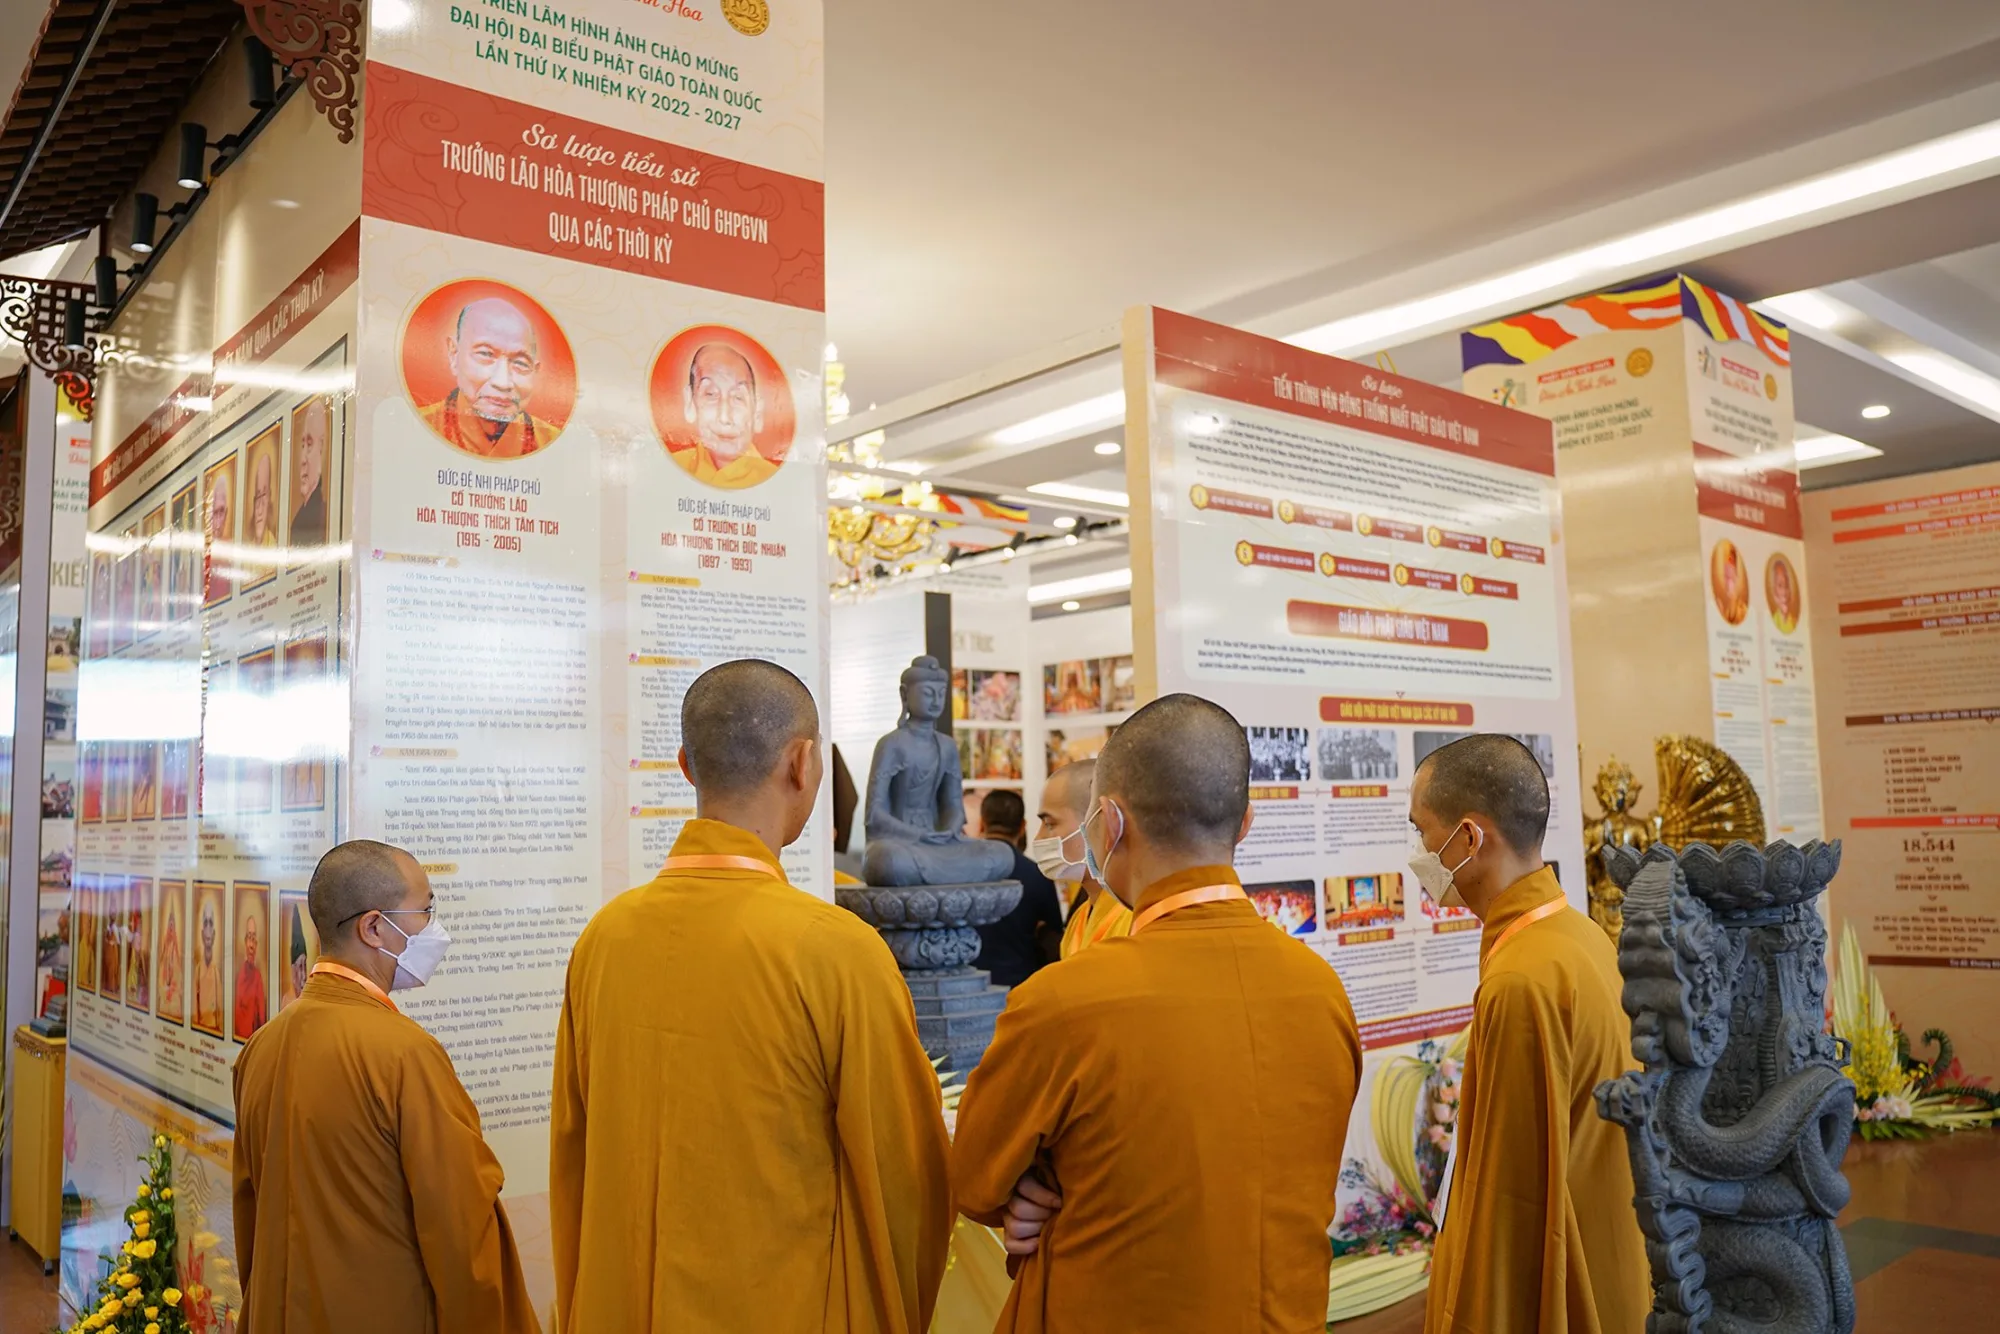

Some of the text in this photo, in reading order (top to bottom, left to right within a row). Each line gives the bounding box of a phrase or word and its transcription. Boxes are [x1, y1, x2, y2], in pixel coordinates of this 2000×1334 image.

[662, 0, 704, 22] Hoa
[450, 6, 764, 113] ĐẠI HỘI ĐẠI BIỂU PHẬT GIÁO TOÀN QUỐC
[533, 5, 566, 29] LÃM
[571, 16, 609, 43] HÌNH
[614, 27, 646, 54] ẢNH
[651, 42, 691, 67] CHÀO
[696, 56, 739, 82] MỪNG
[476, 40, 509, 65] LẦN
[514, 52, 548, 76] THỨ
[552, 63, 568, 82] IX
[573, 69, 622, 98] NHIỆM
[627, 86, 647, 104] KỲ
[651, 93, 690, 117] 2022
[704, 108, 741, 130] 2027
[563, 135, 617, 167] lược
[620, 151, 665, 179] tiểu
[670, 166, 701, 187] sử
[441, 139, 768, 245] TRƯỞNG LÃO HÒA THƯỢNG PHÁP CHỦ GHPGVN
[549, 211, 673, 264] QUA CÁC THỜI KỲ
[254, 320, 271, 354] QUA
[272, 304, 289, 338] CÁC
[290, 284, 310, 323] THỜI
[311, 267, 324, 305] KỲ
[438, 468, 541, 496] ĐỨC ĐỆ NHỊ PHÁP CHỦ
[451, 489, 528, 513] CỐ TRƯỞNG LÃO
[416, 506, 559, 536] HÒA THƯỢNG THÍCH TÂM TỊCH
[678, 497, 696, 512] ĐỨC
[732, 503, 753, 520] PHÁP
[754, 505, 771, 522] CHỦ
[456, 531, 481, 548] (1915
[493, 534, 522, 552] 2005)
